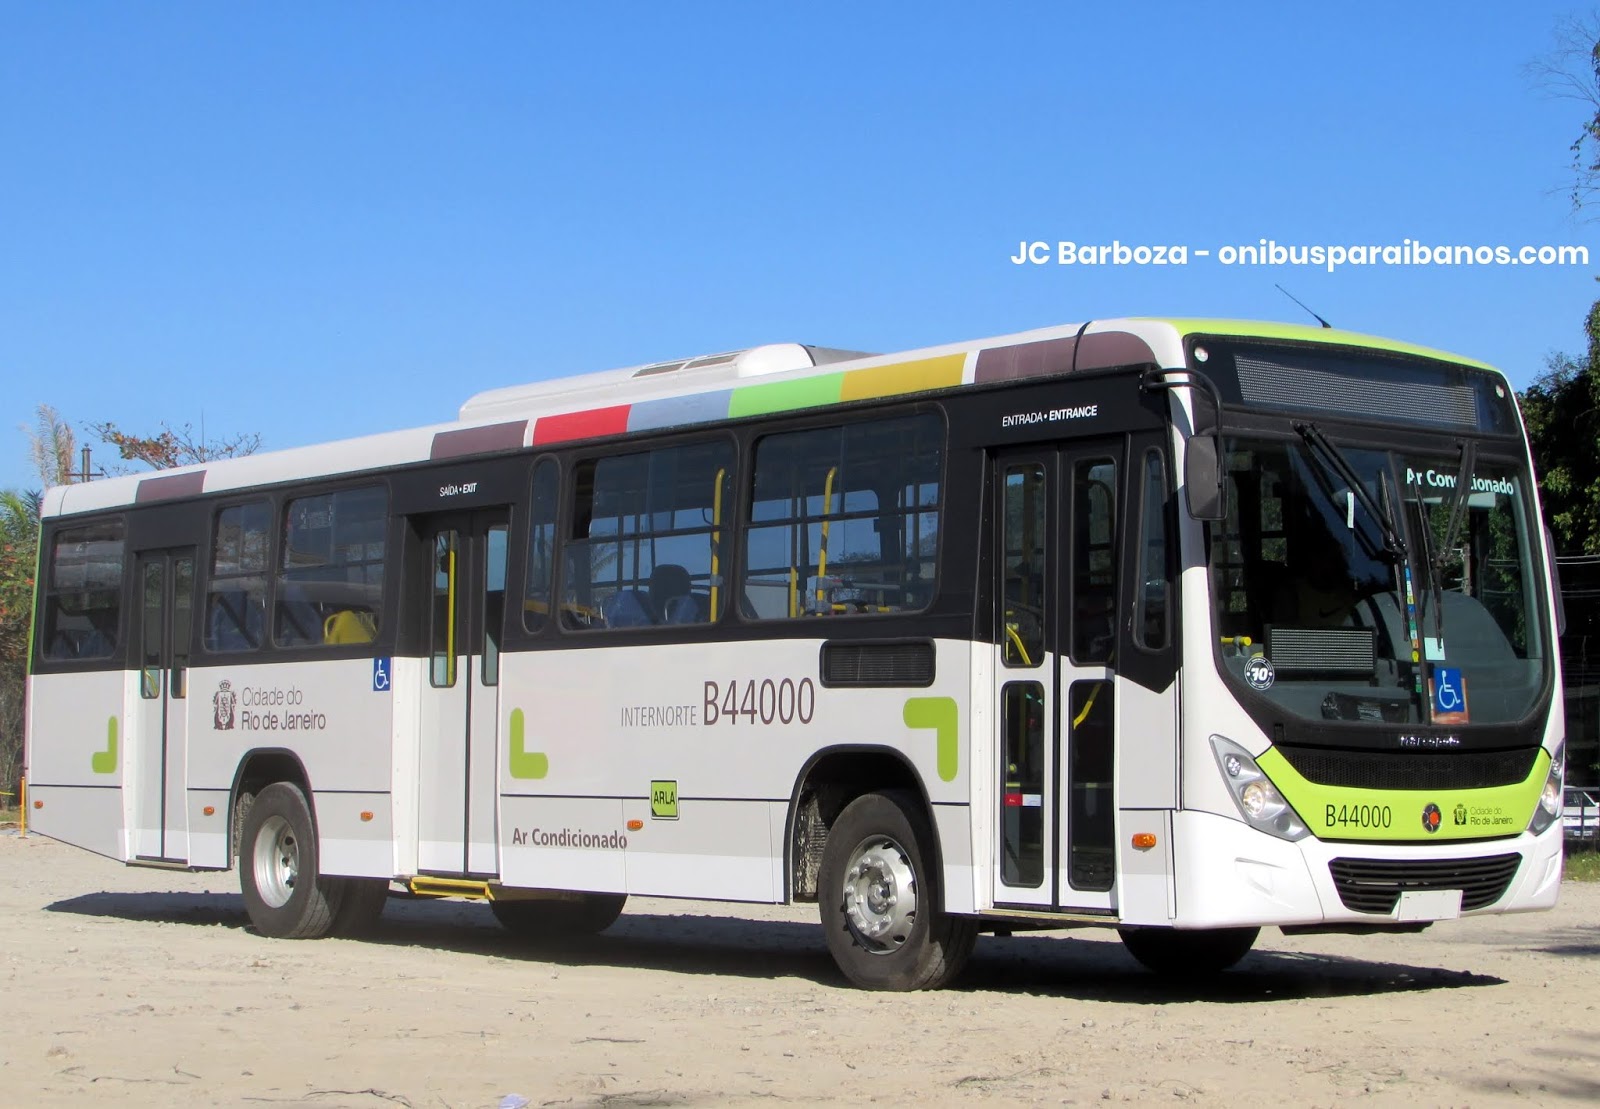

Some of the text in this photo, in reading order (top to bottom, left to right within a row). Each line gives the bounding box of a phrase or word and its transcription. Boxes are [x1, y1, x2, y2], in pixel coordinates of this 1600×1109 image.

[1002, 405, 1098, 427] ENTRADA ENTRANCE
[439, 482, 478, 497] SAÍDA EXIT
[1406, 468, 1514, 495] Ar Conionado
[242, 686, 303, 707] Cidade do
[620, 677, 815, 727] INTERNORTE B44000
[241, 709, 327, 731] Rio de Janeiro
[653, 790, 675, 806] ARLA
[1325, 804, 1392, 829] B44000
[1470, 816, 1514, 825] Rio de Janeiro
[512, 827, 628, 849] Ar Condicionado
